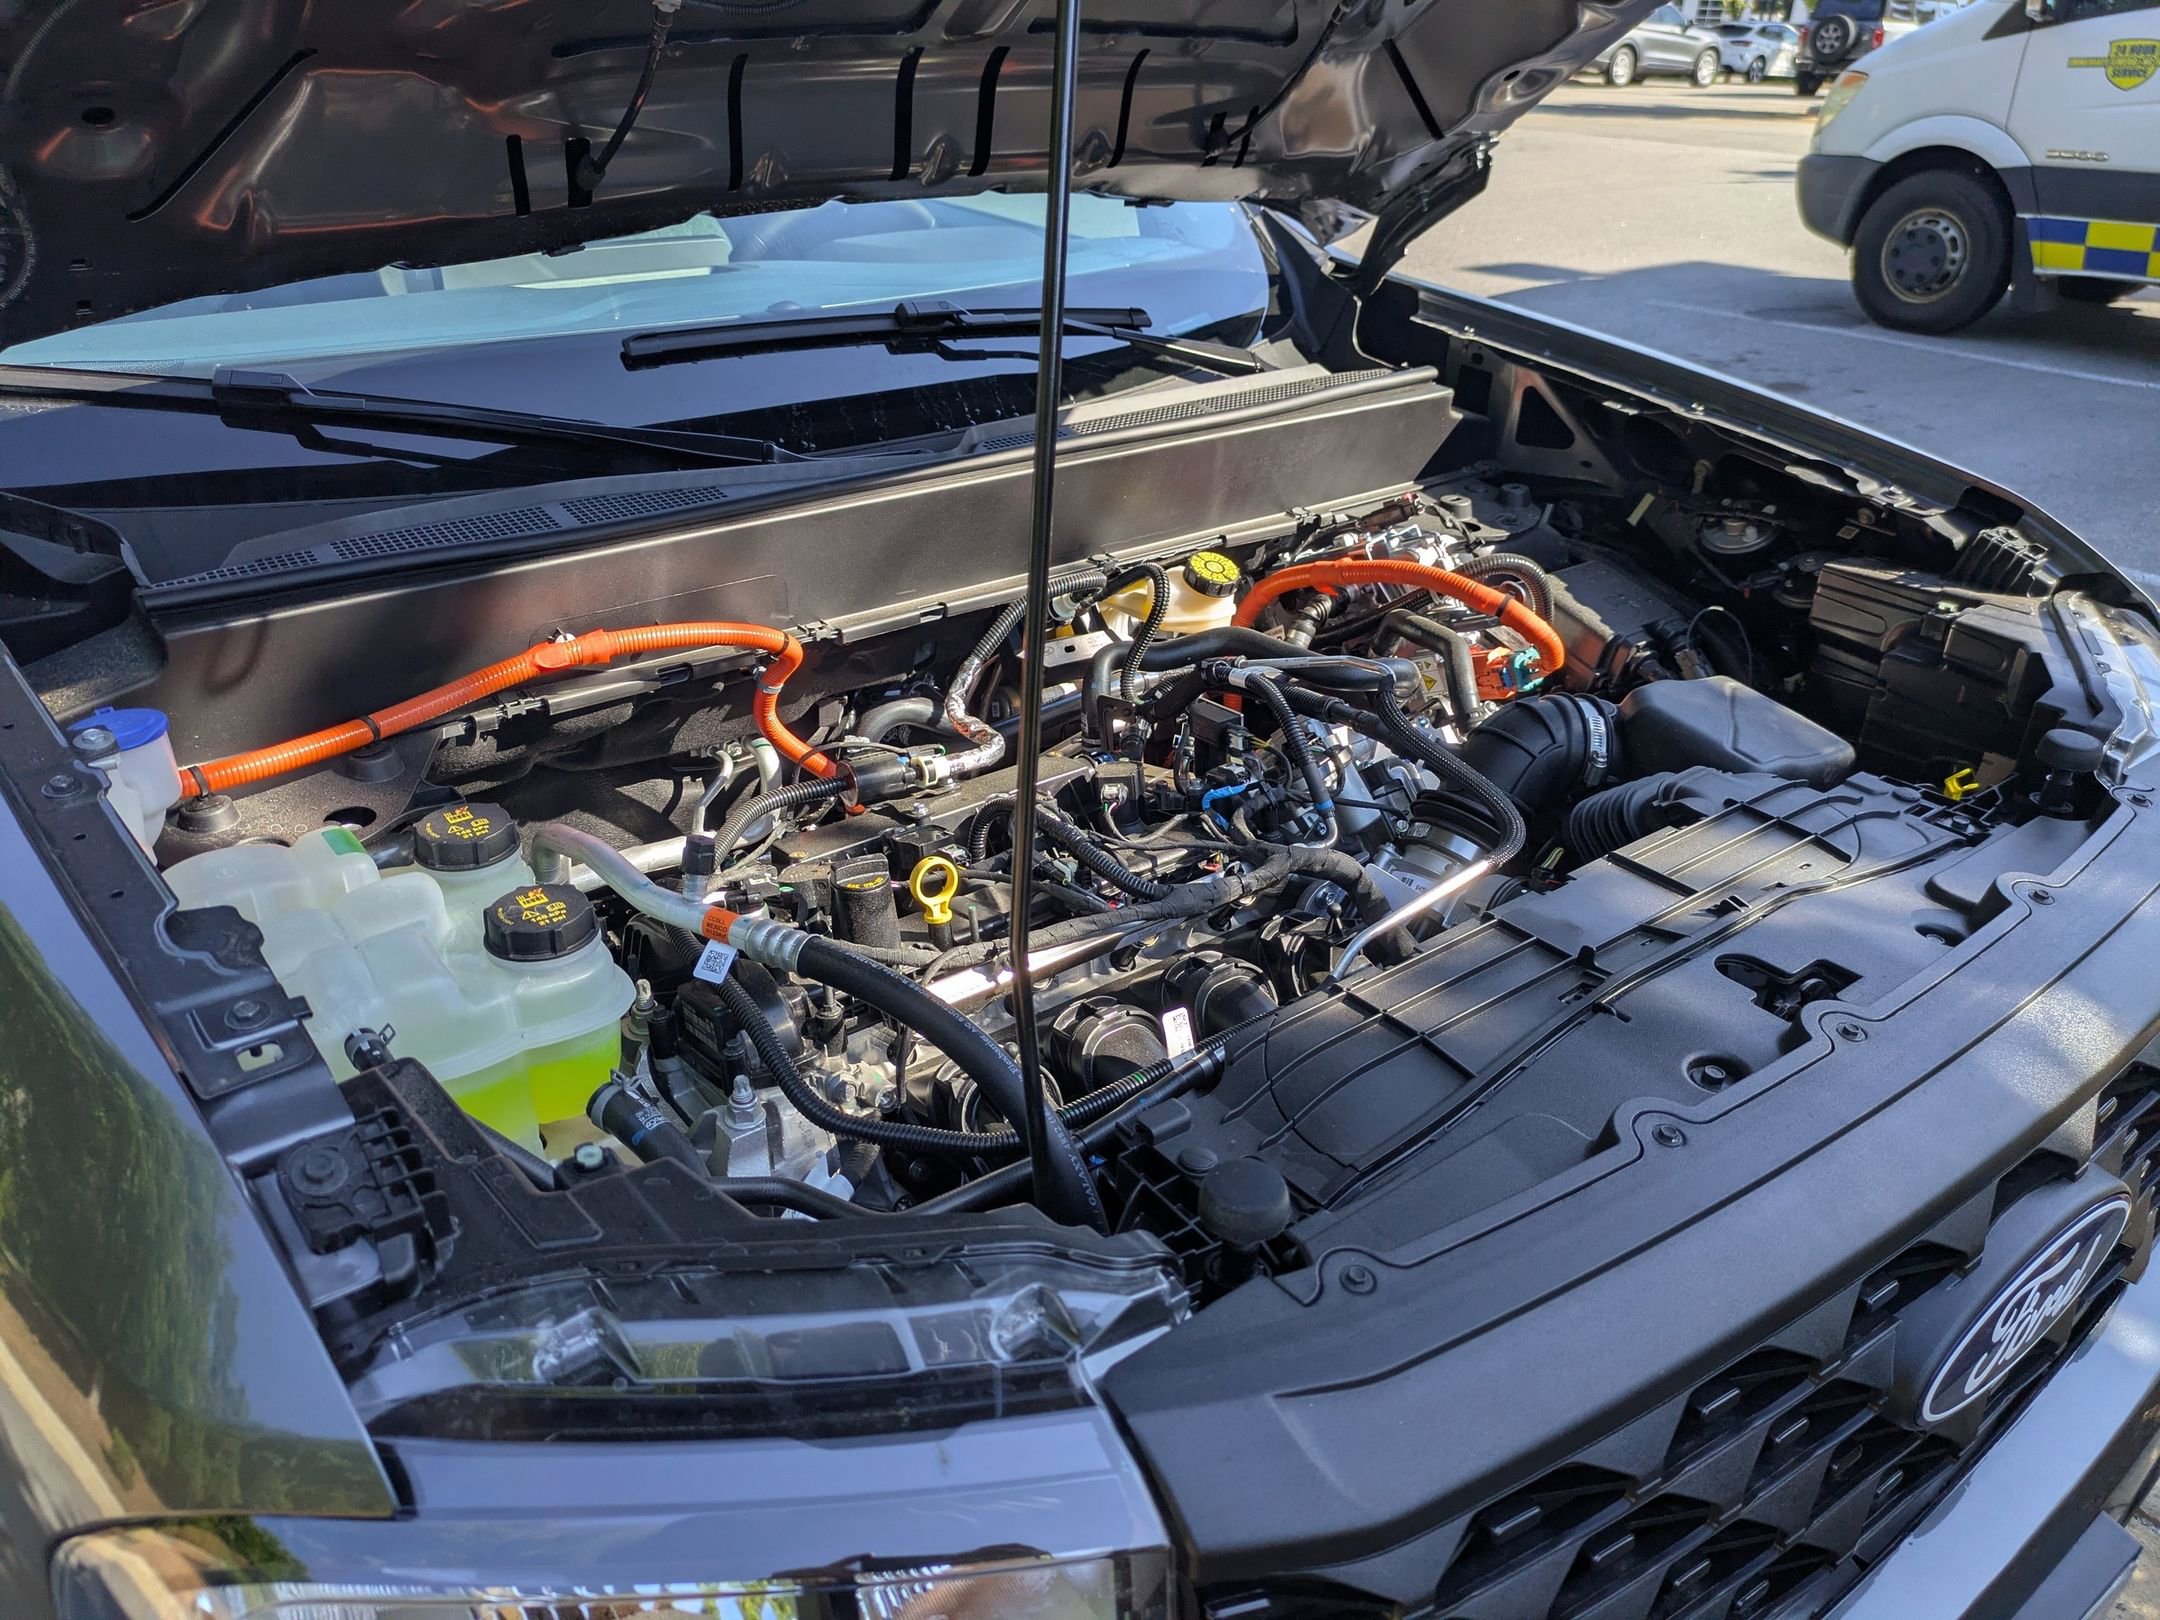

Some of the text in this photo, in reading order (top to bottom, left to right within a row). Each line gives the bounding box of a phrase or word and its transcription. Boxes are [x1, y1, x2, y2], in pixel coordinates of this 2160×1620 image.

[706, 922, 728, 932] MEXICO
[908, 981, 929, 997] HOSE
[931, 996, 964, 1022] SUCTION
[964, 1021, 977, 1033] A/C
[979, 1034, 1018, 1073] Flexbarrier
[1068, 1153, 1096, 1206] GALAXY
[1963, 1233, 2102, 1395] Ford
